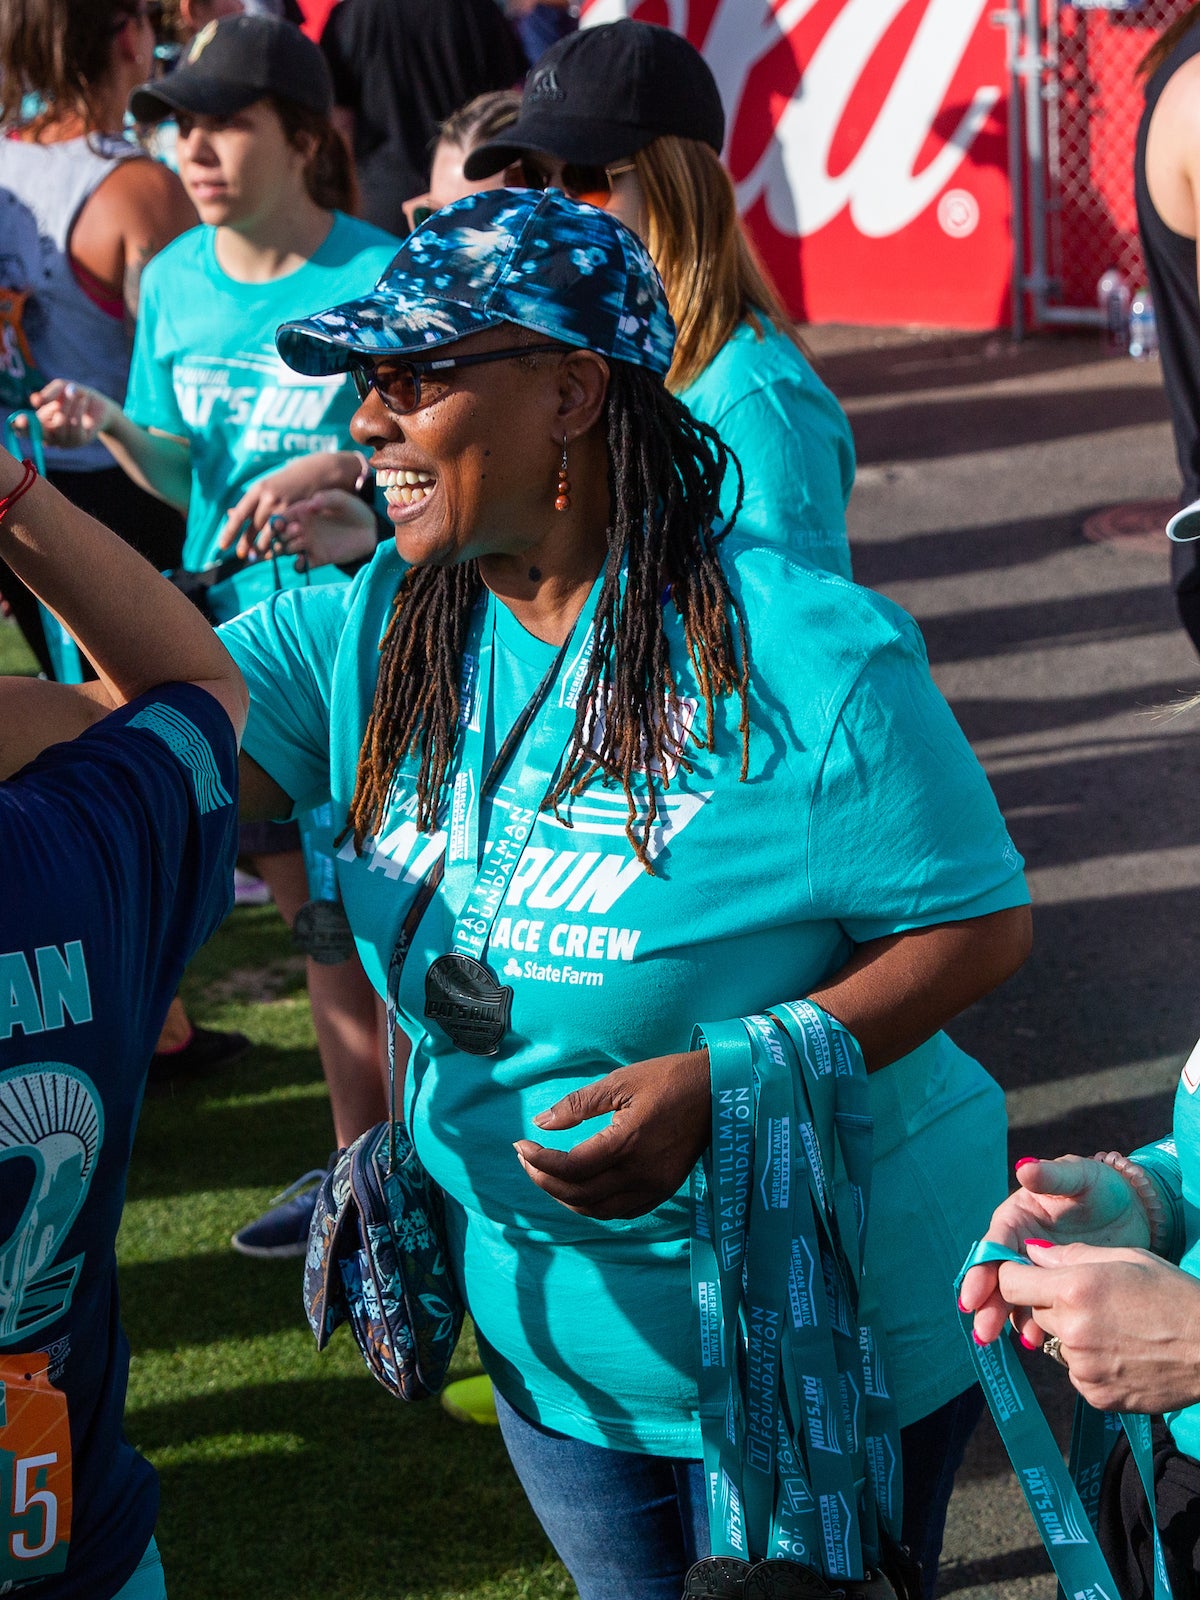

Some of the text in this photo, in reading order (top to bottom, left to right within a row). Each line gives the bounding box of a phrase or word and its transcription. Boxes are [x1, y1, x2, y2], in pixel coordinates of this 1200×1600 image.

[456, 806, 524, 943] PAT TILLMAN
[468, 808, 535, 948] FOUNDATION
[490, 916, 642, 962] ACE CREW
[760, 1025, 787, 1067] PAT'S
[806, 1025, 825, 1076] AMERICAN
[719, 1089, 734, 1232] PAT TILLMAN
[735, 1087, 750, 1228] FOUNDATION
[771, 1118, 783, 1209] AMERICAN FAMILY
[780, 1122, 791, 1205] INSURANCE
[792, 1238, 812, 1326] AMERICAN FAMILY
[699, 1284, 710, 1363] INSURANCE
[707, 1281, 720, 1367] AMERICAN FAMILY
[750, 1306, 765, 1433] PAT TILLMAN
[761, 1309, 779, 1440] FOUNDATION
[997, 1376, 1019, 1414] FAMILY
[802, 1375, 826, 1450] PAT'S RUN
[874, 1436, 887, 1486] AMERICAN
[729, 1514, 743, 1552] PAT'S
[828, 1494, 846, 1576] AMERICAN FAMILY
[1022, 1467, 1069, 1546] PAT'S RUN
